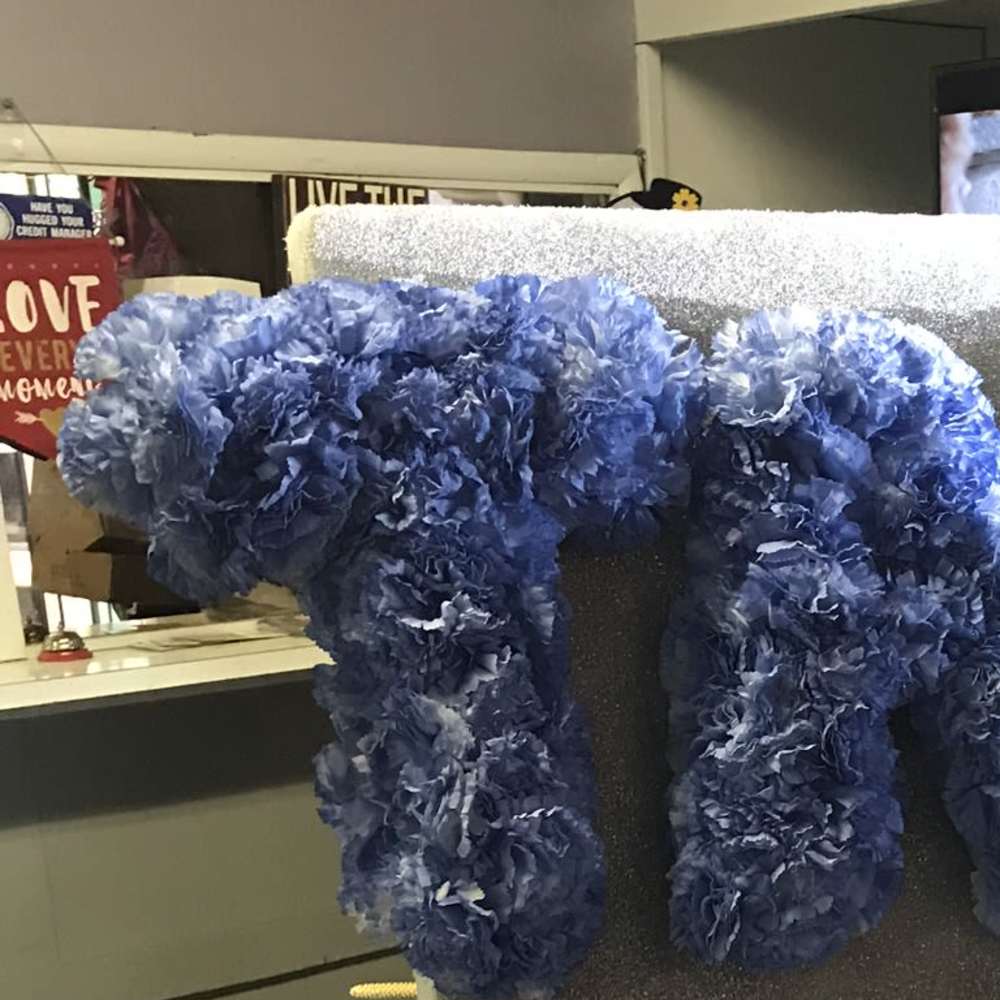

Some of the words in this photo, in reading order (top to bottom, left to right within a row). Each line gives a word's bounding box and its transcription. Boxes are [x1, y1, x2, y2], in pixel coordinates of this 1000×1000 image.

[56, 203, 74, 214] YOU
[16, 225, 48, 237] CREDIT
[50, 226, 93, 238] MANAGER
[0, 275, 101, 333] OVE
